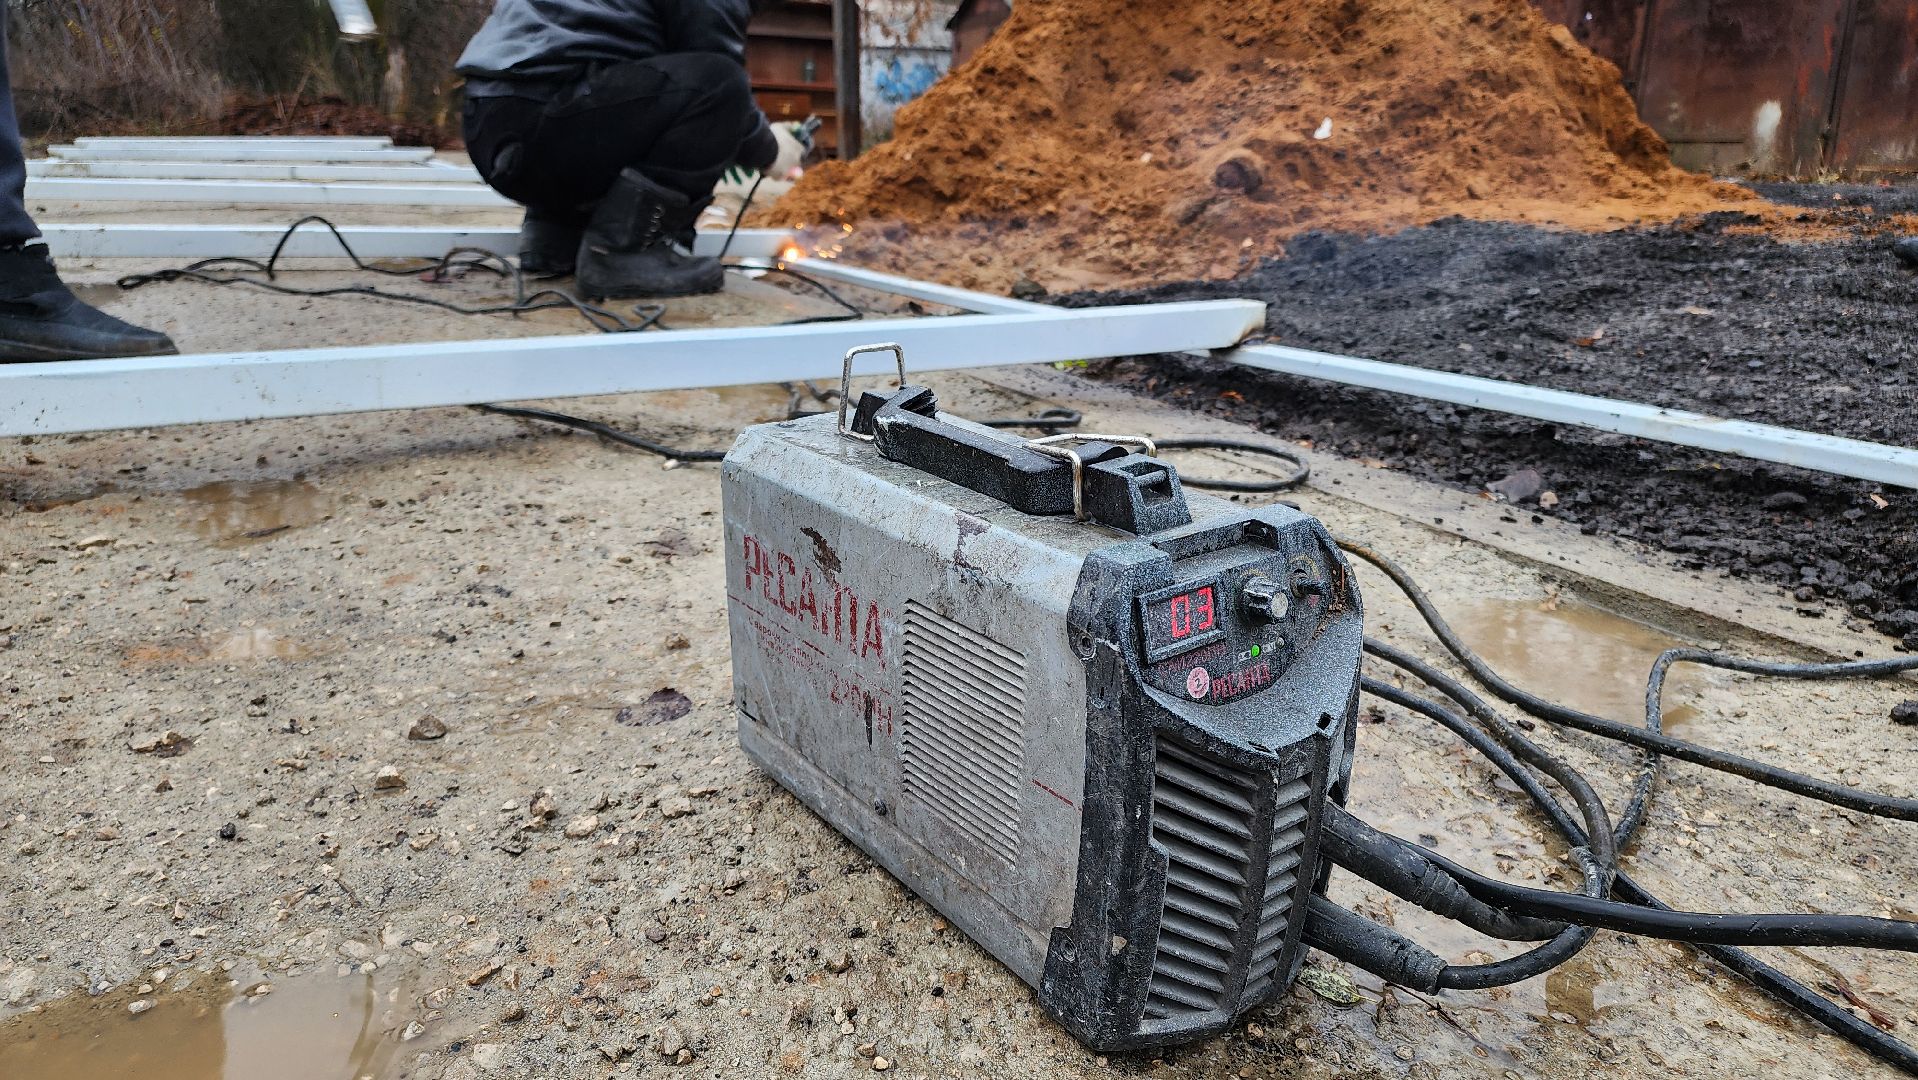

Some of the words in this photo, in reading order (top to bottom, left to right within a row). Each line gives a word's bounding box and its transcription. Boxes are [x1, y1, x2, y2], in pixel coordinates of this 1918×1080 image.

[744, 535, 886, 672] РЕСАНТА
[1171, 587, 1213, 638] 03
[1212, 662, 1271, 699] РЕСАНТА
